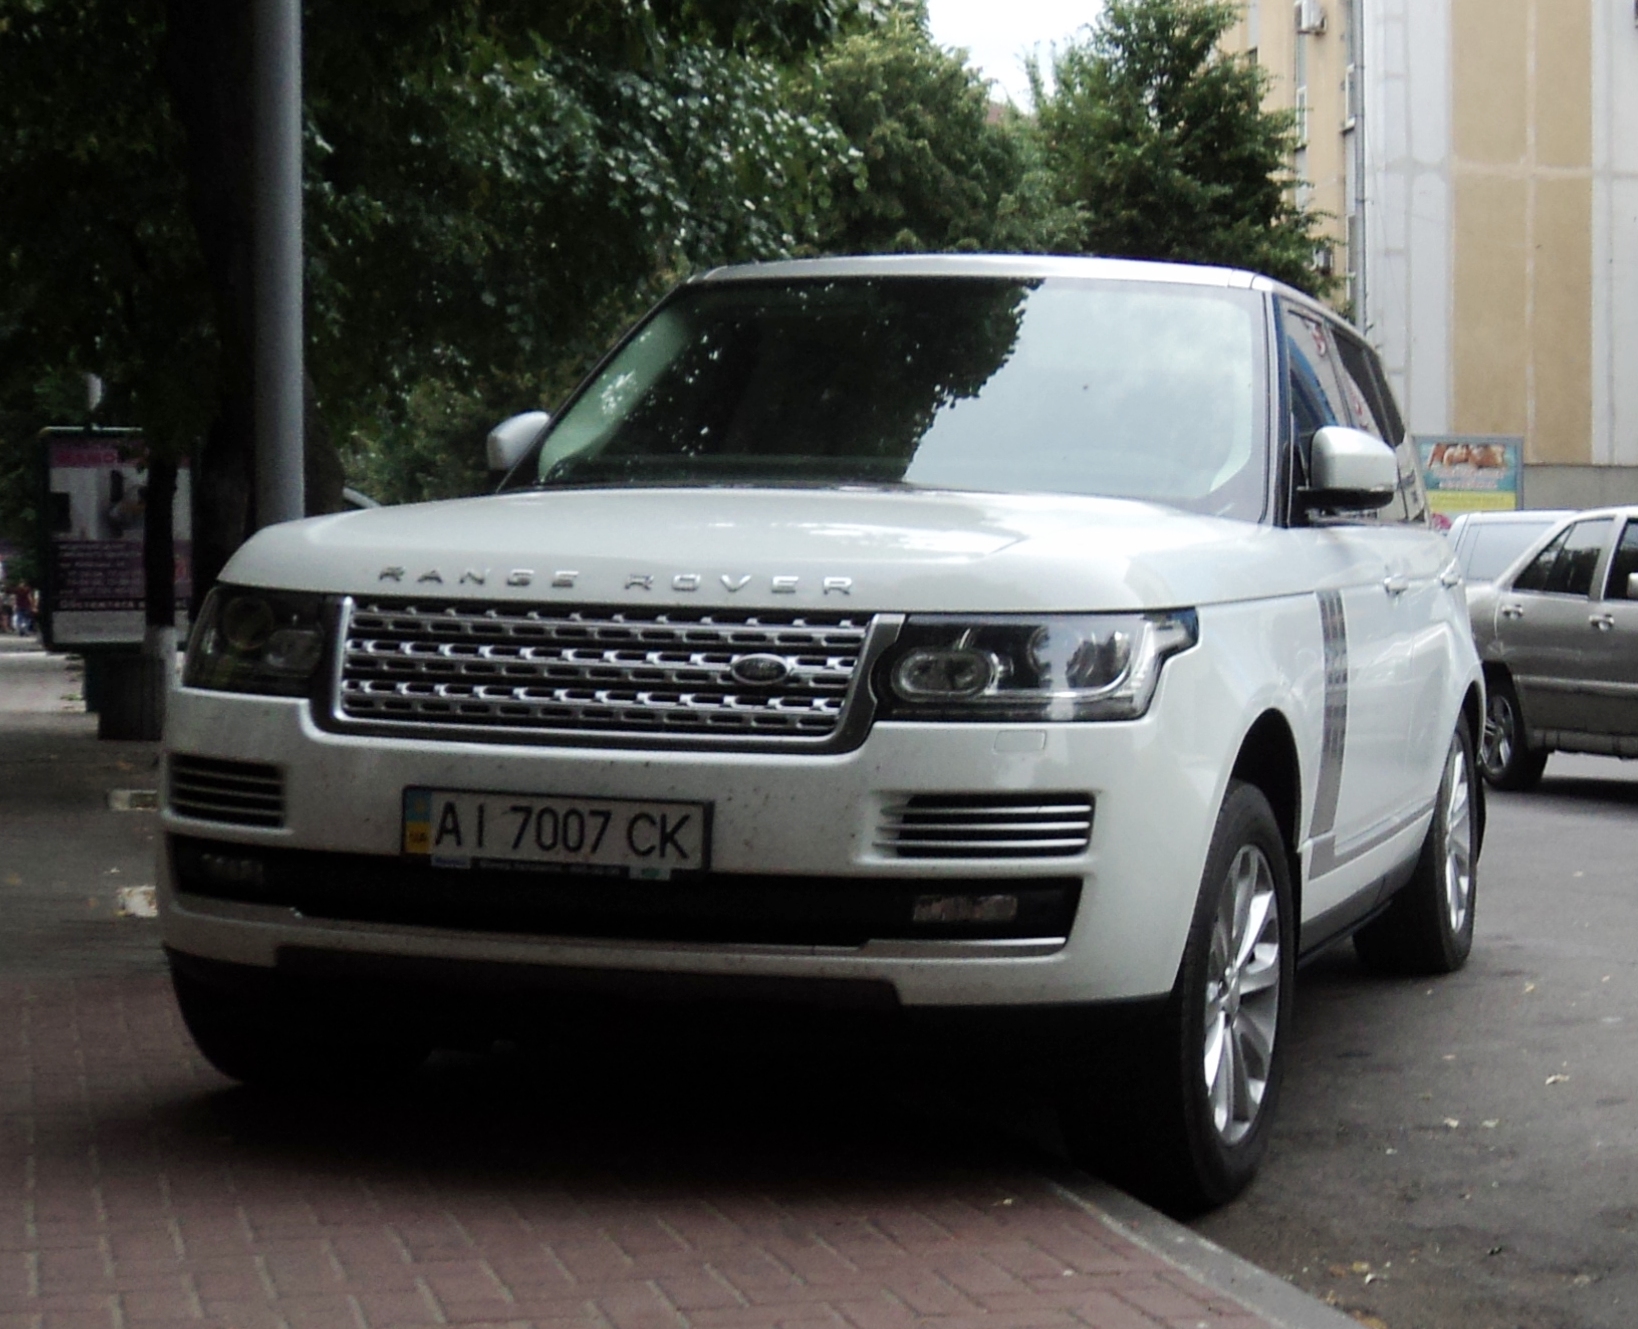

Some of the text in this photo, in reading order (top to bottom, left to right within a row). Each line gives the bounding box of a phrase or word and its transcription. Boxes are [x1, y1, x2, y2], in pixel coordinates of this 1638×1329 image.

[379, 565, 854, 596] RANGE ROVER
[435, 801, 691, 860] AI 7007 CK
